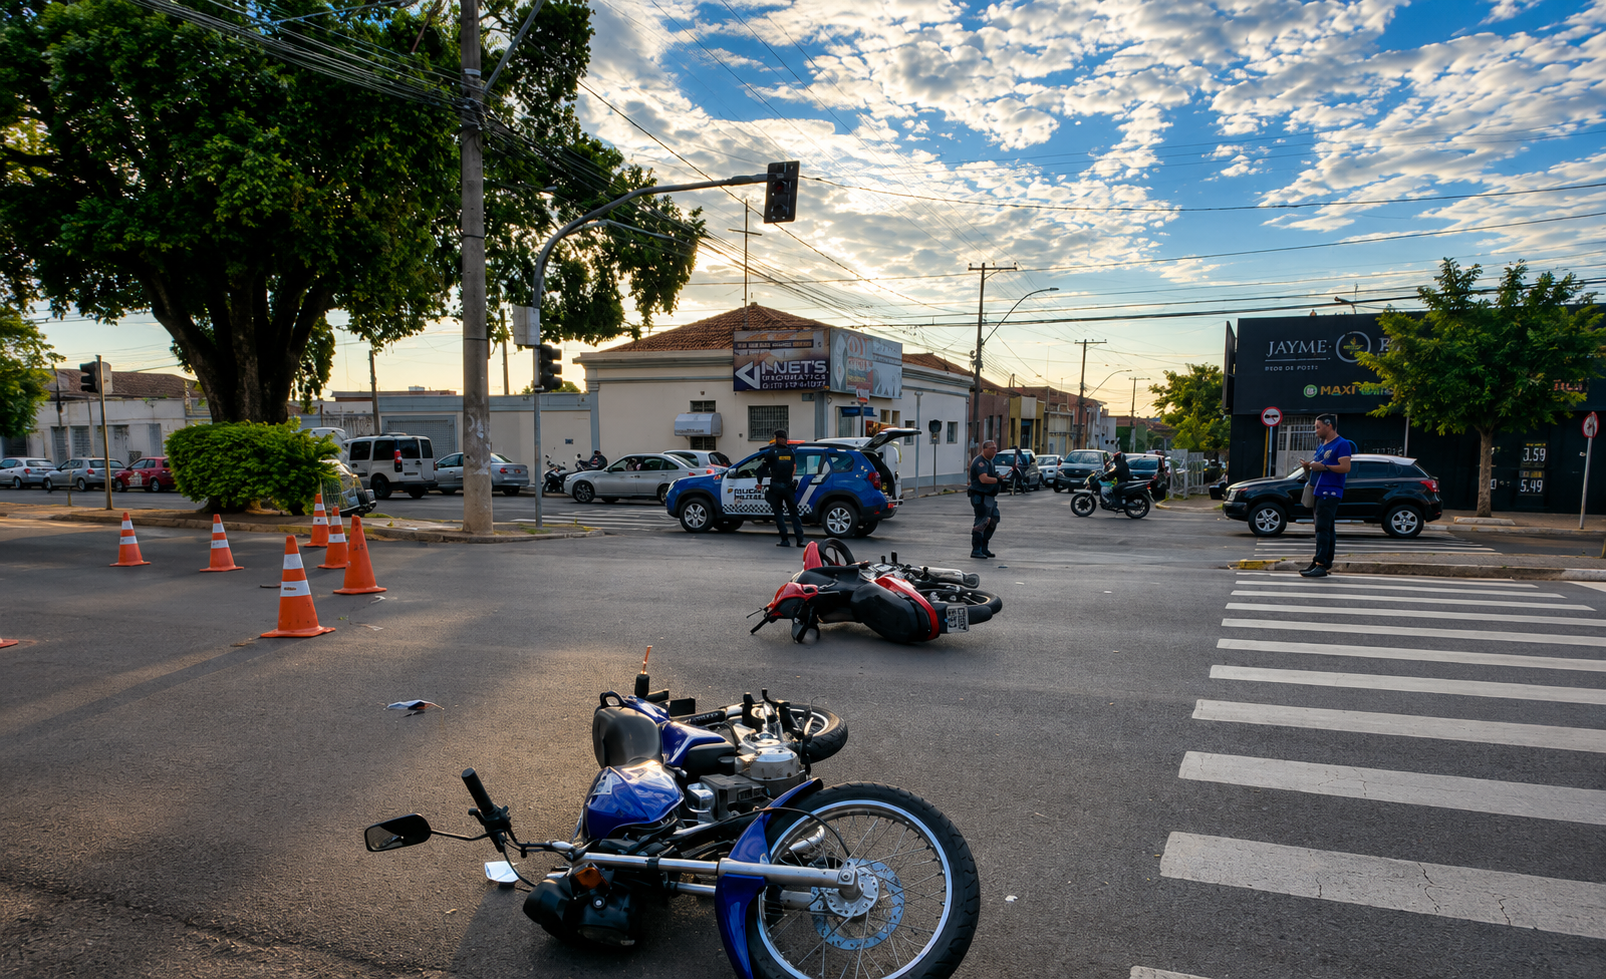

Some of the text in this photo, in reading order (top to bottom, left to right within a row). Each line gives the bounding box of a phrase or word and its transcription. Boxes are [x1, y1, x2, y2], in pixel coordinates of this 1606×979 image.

[1265, 340, 1327, 357] JAYME
[1320, 385, 1356, 396] MAXI
[1522, 447, 1547, 462] 3.59
[1520, 479, 1543, 493] 5.49
